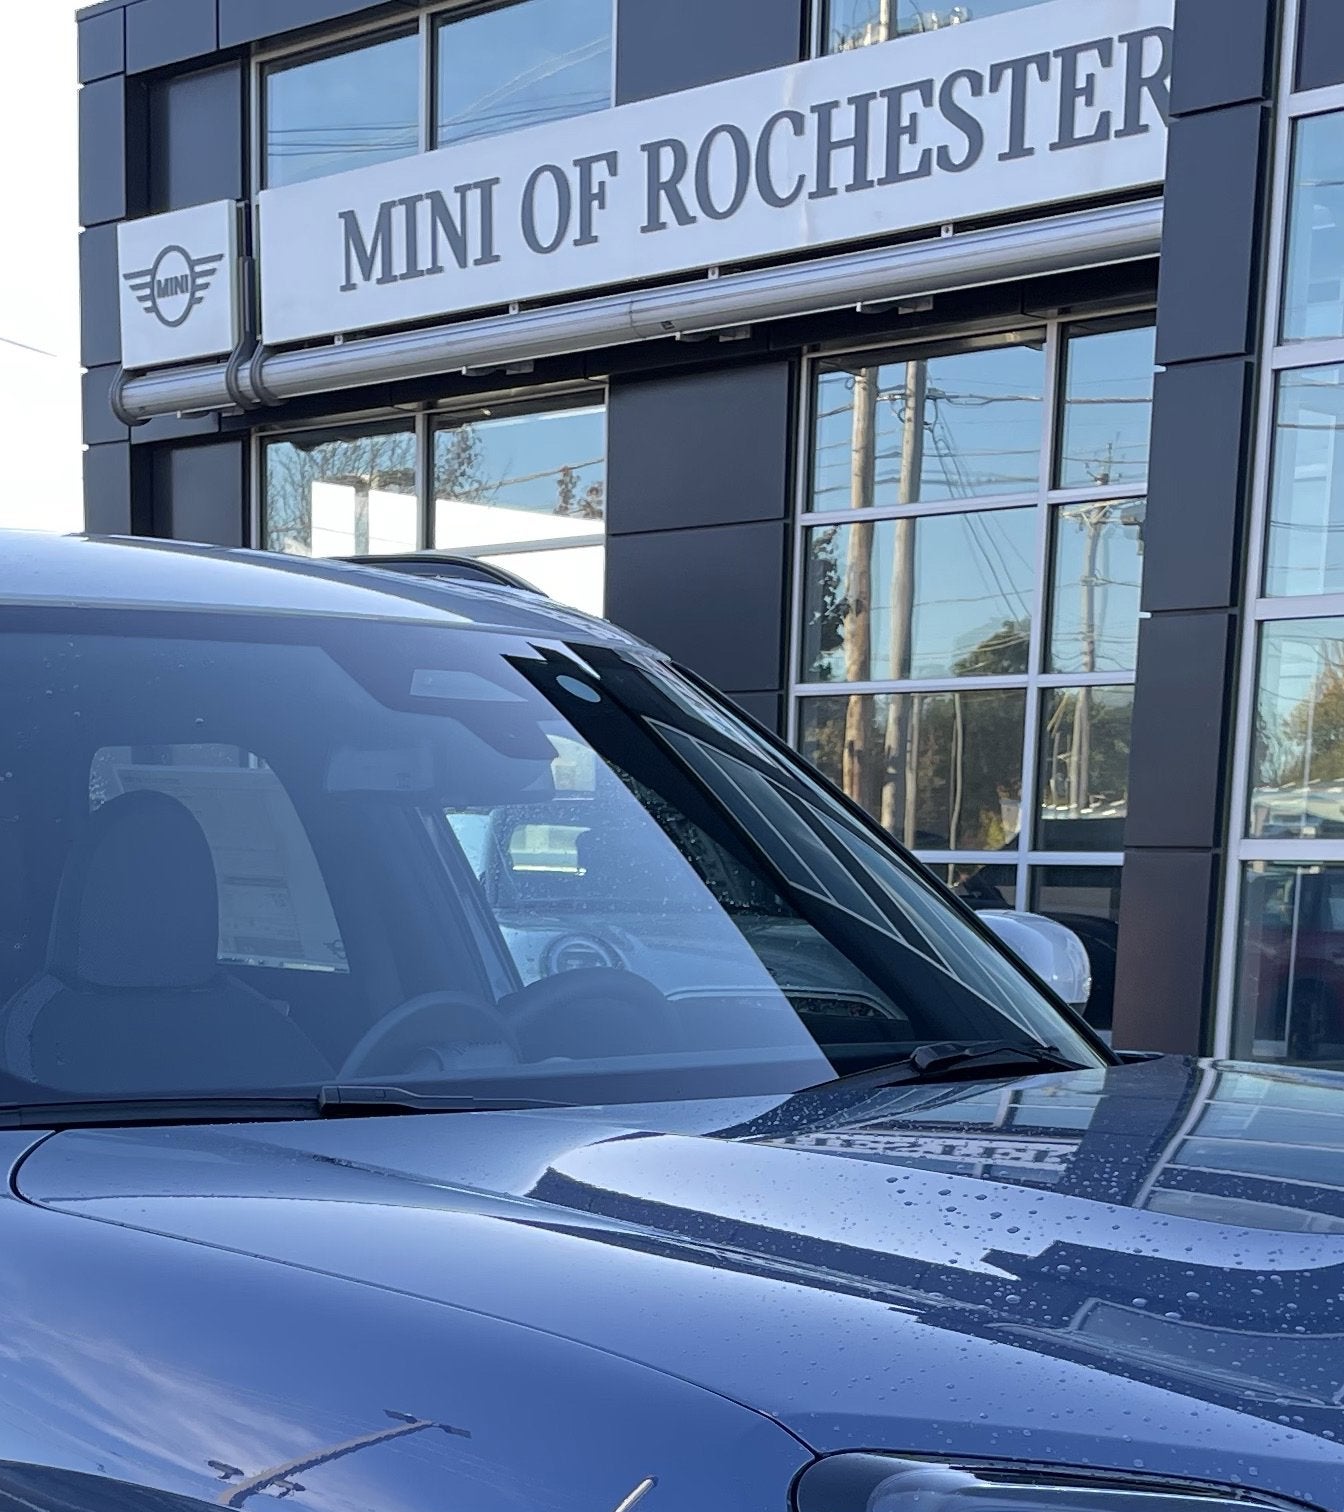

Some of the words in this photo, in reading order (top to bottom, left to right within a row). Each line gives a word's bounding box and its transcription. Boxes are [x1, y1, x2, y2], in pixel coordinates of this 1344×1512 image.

[338, 177, 500, 292] MINI
[521, 150, 618, 255] OF
[640, 26, 1174, 234] ROCHESTER
[156, 274, 189, 299] MINI
